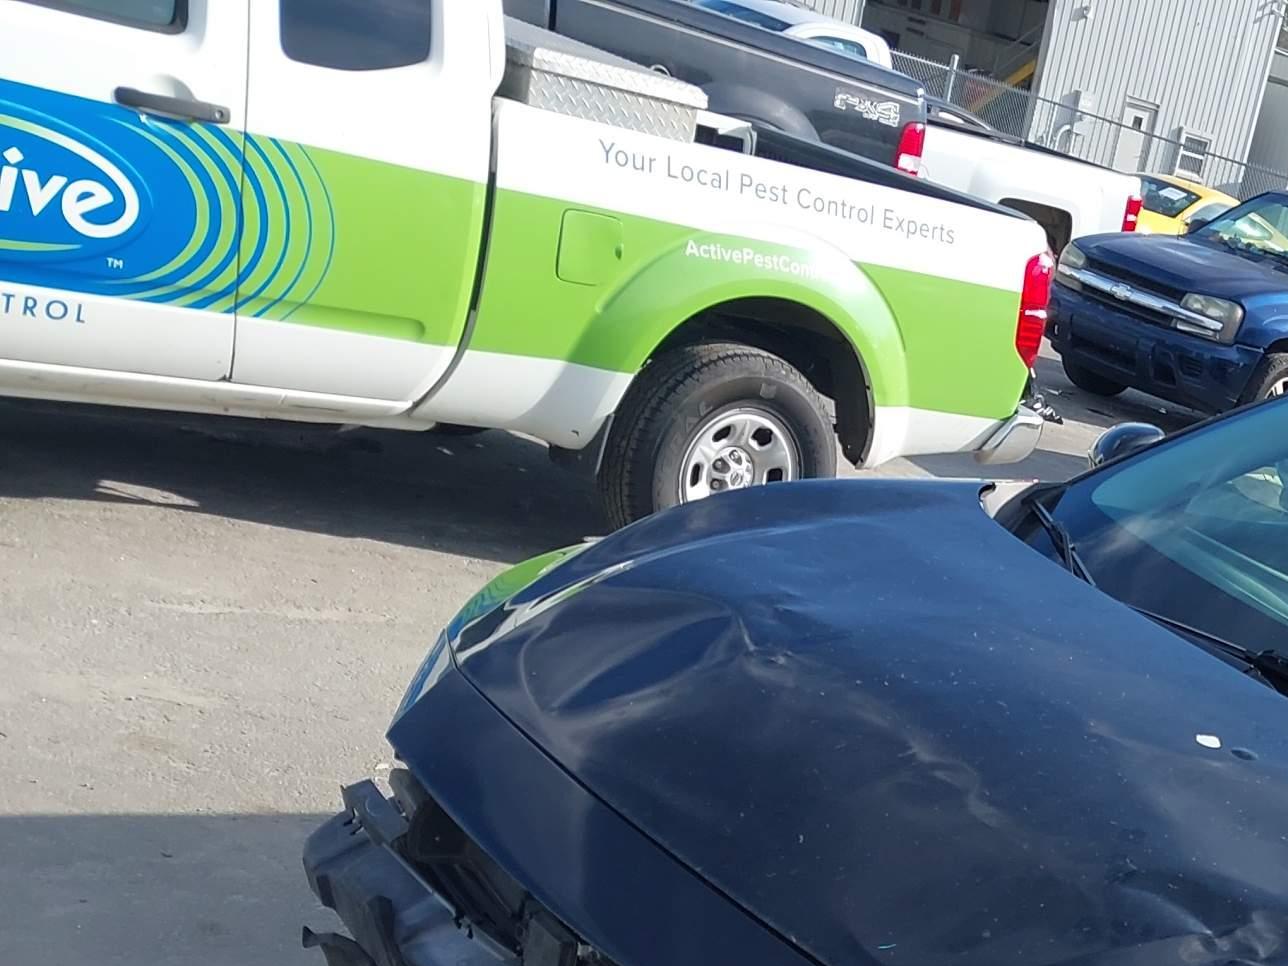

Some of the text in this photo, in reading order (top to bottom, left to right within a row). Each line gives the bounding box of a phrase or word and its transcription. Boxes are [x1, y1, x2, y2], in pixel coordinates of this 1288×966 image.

[598, 138, 955, 245] Your Local Pest Control Experts
[106, 257, 124, 269] TM
[2, 292, 86, 324] TROL
